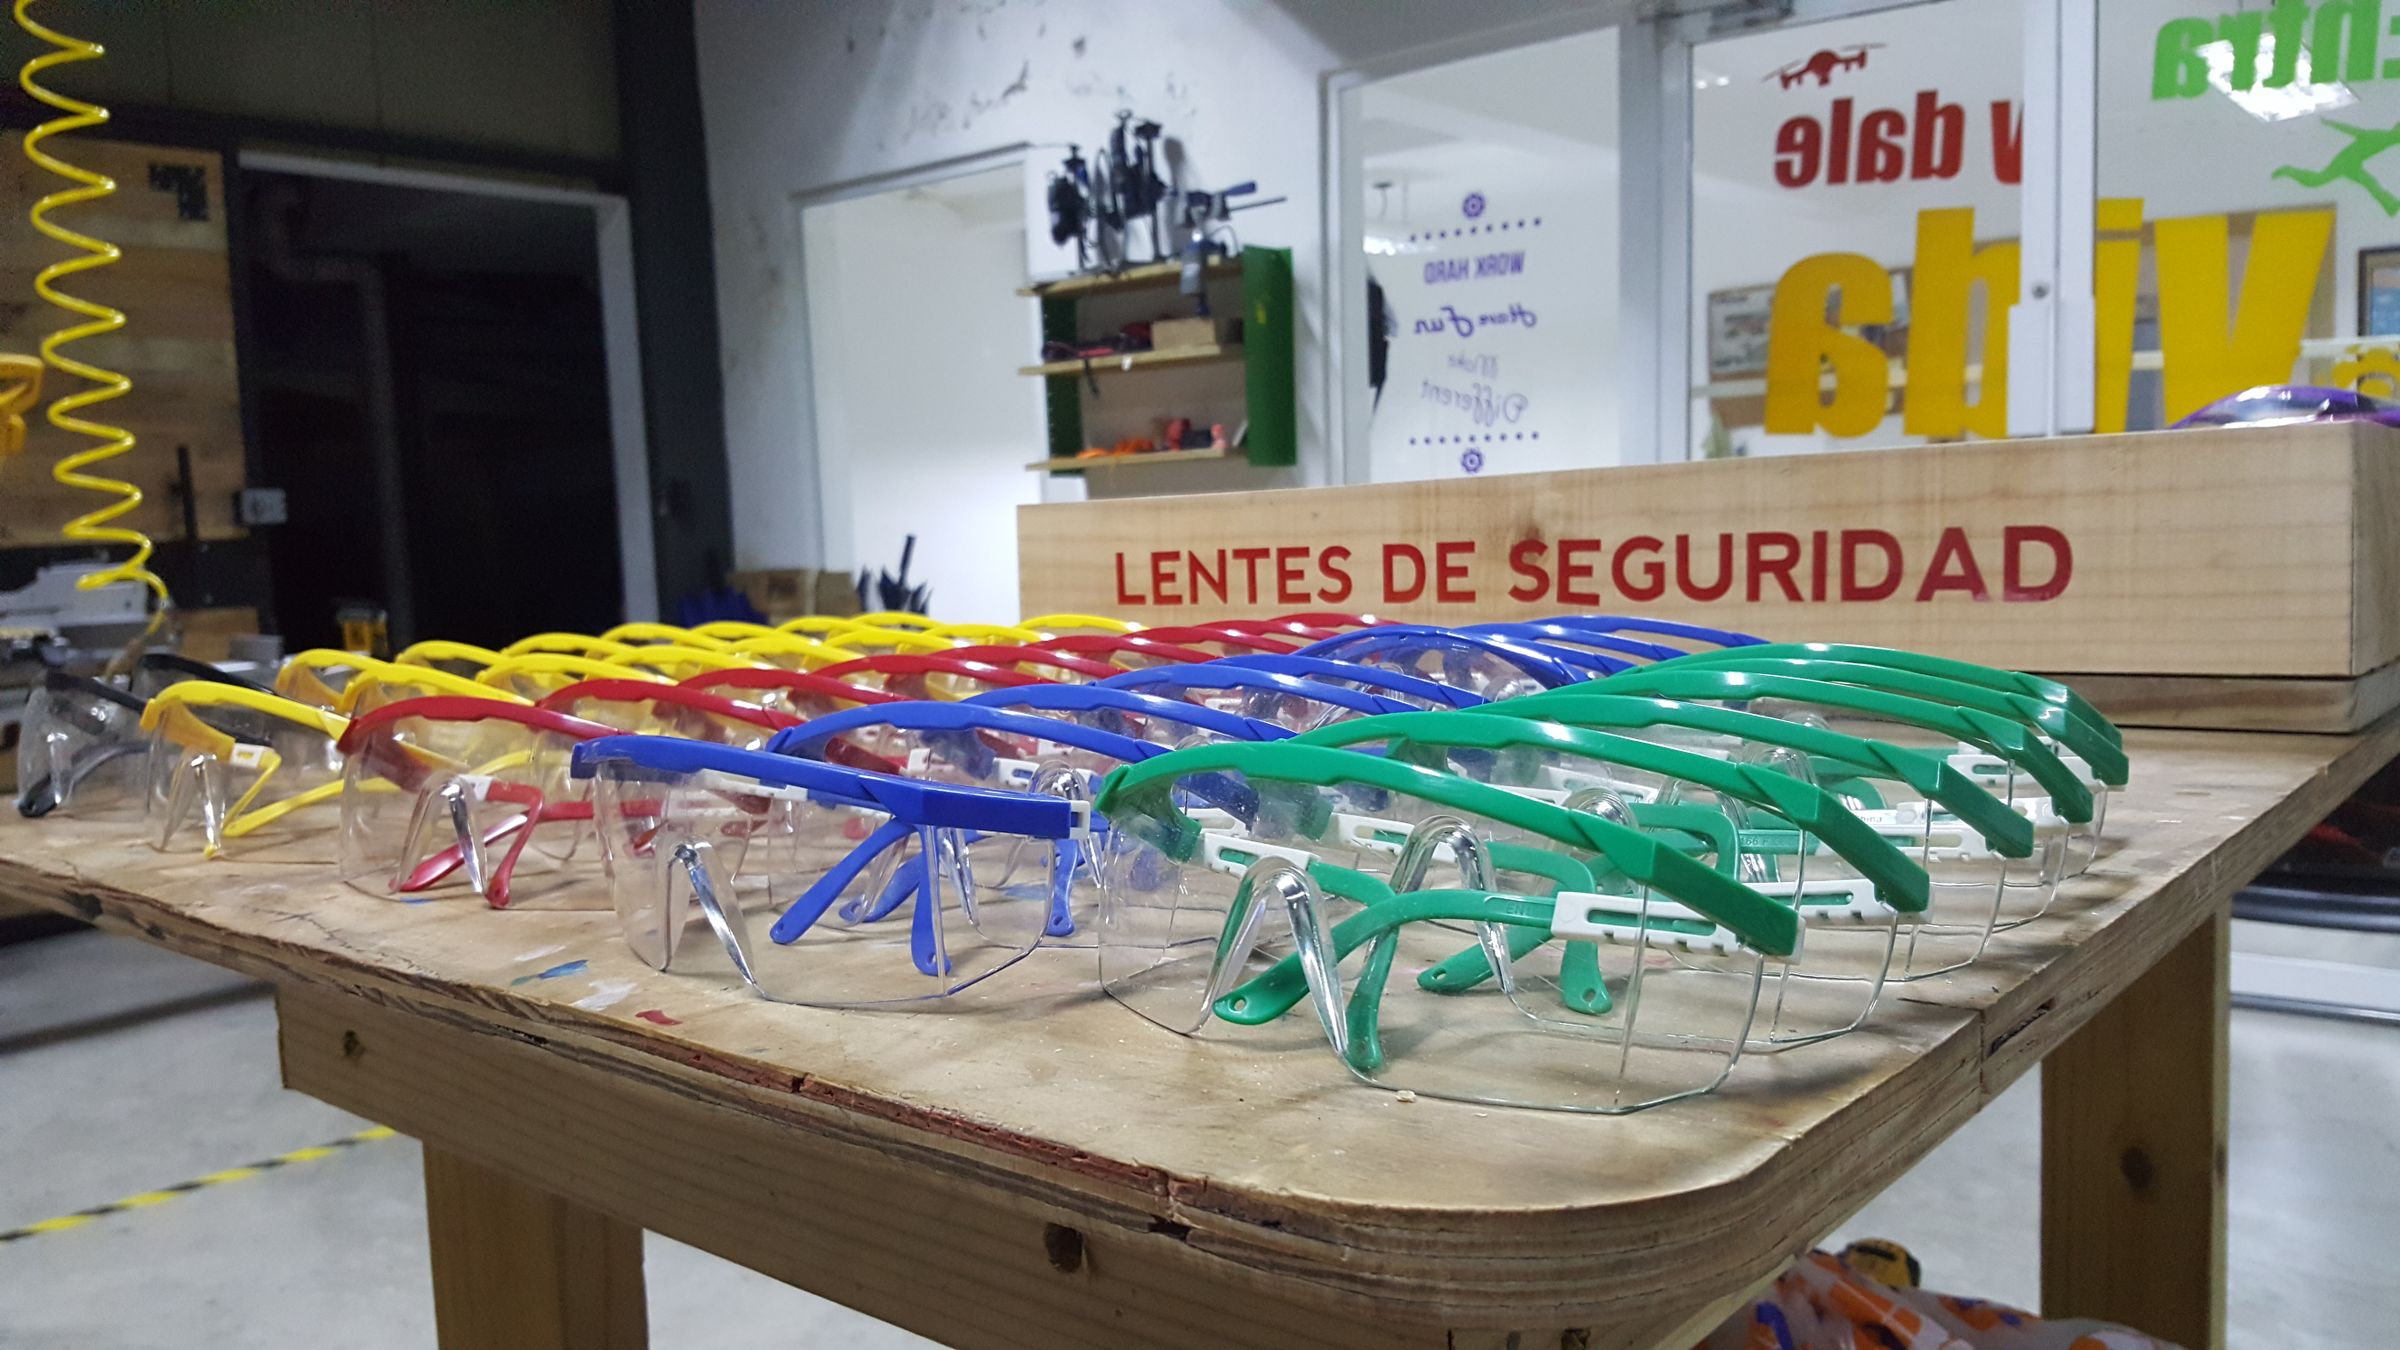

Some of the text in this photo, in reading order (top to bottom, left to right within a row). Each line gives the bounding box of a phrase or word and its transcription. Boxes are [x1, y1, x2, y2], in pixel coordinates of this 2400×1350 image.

[1115, 526, 2073, 605] LENTES DE SEGURIDAD
